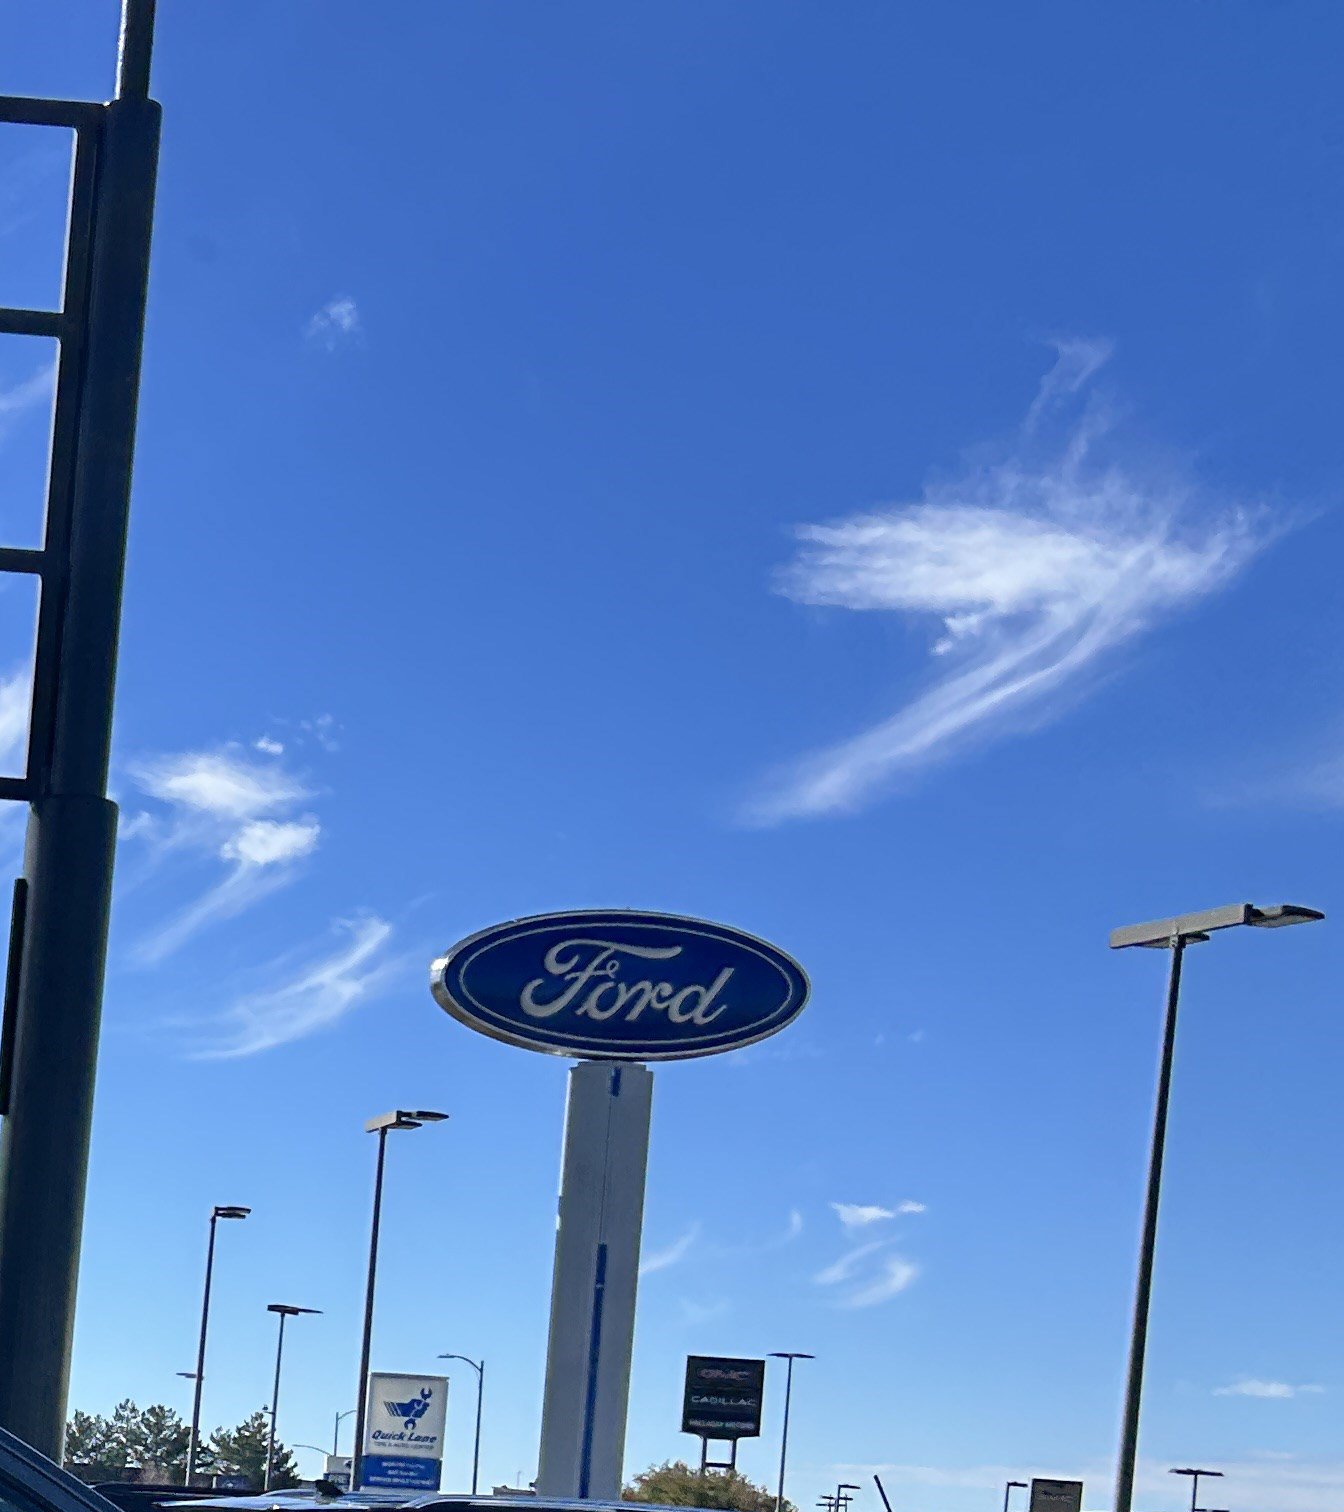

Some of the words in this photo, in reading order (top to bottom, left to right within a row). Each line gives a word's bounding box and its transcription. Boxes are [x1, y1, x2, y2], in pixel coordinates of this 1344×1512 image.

[519, 938, 736, 1026] Ford
[691, 1395, 756, 1407] CADILLAC
[372, 1430, 405, 1441] Quick
[407, 1432, 437, 1443] Lane
